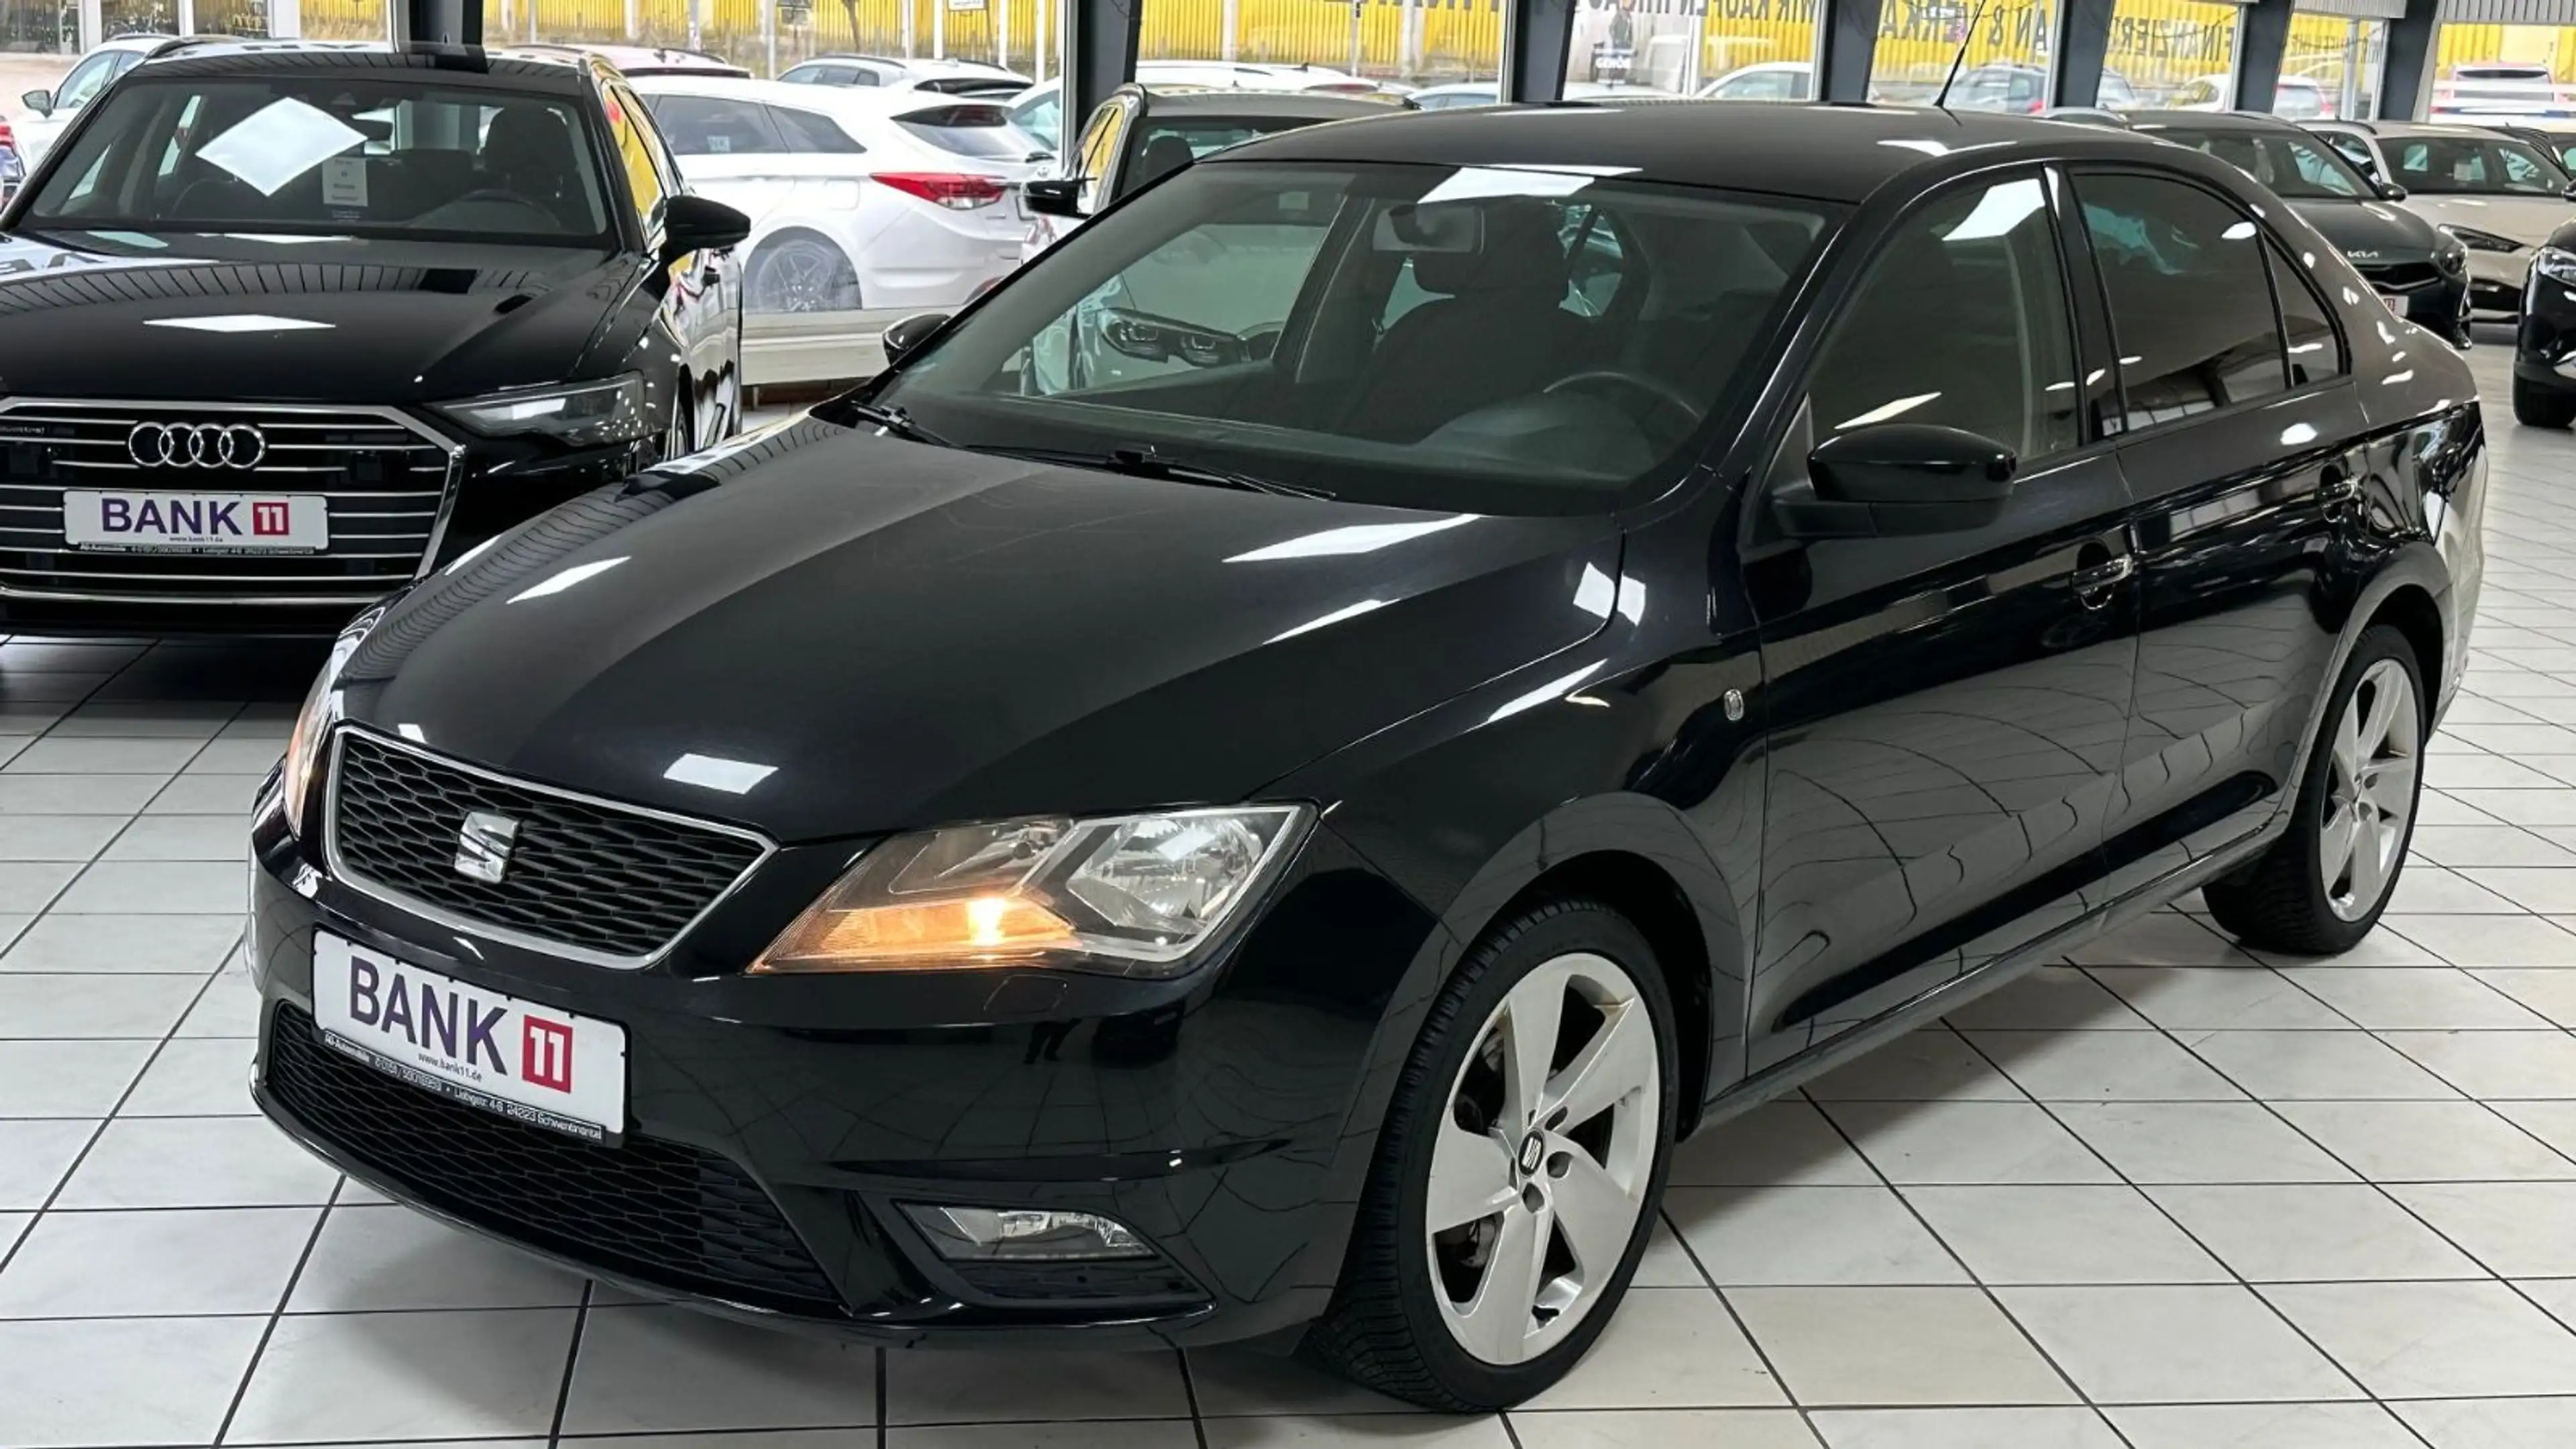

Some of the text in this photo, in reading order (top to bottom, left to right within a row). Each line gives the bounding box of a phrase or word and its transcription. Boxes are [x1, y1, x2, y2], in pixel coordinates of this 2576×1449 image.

[102, 498, 284, 535] BANK 11
[351, 956, 507, 1076] BANK
[530, 1026, 564, 1082] 11
[418, 1053, 482, 1082] www.bank11.de
